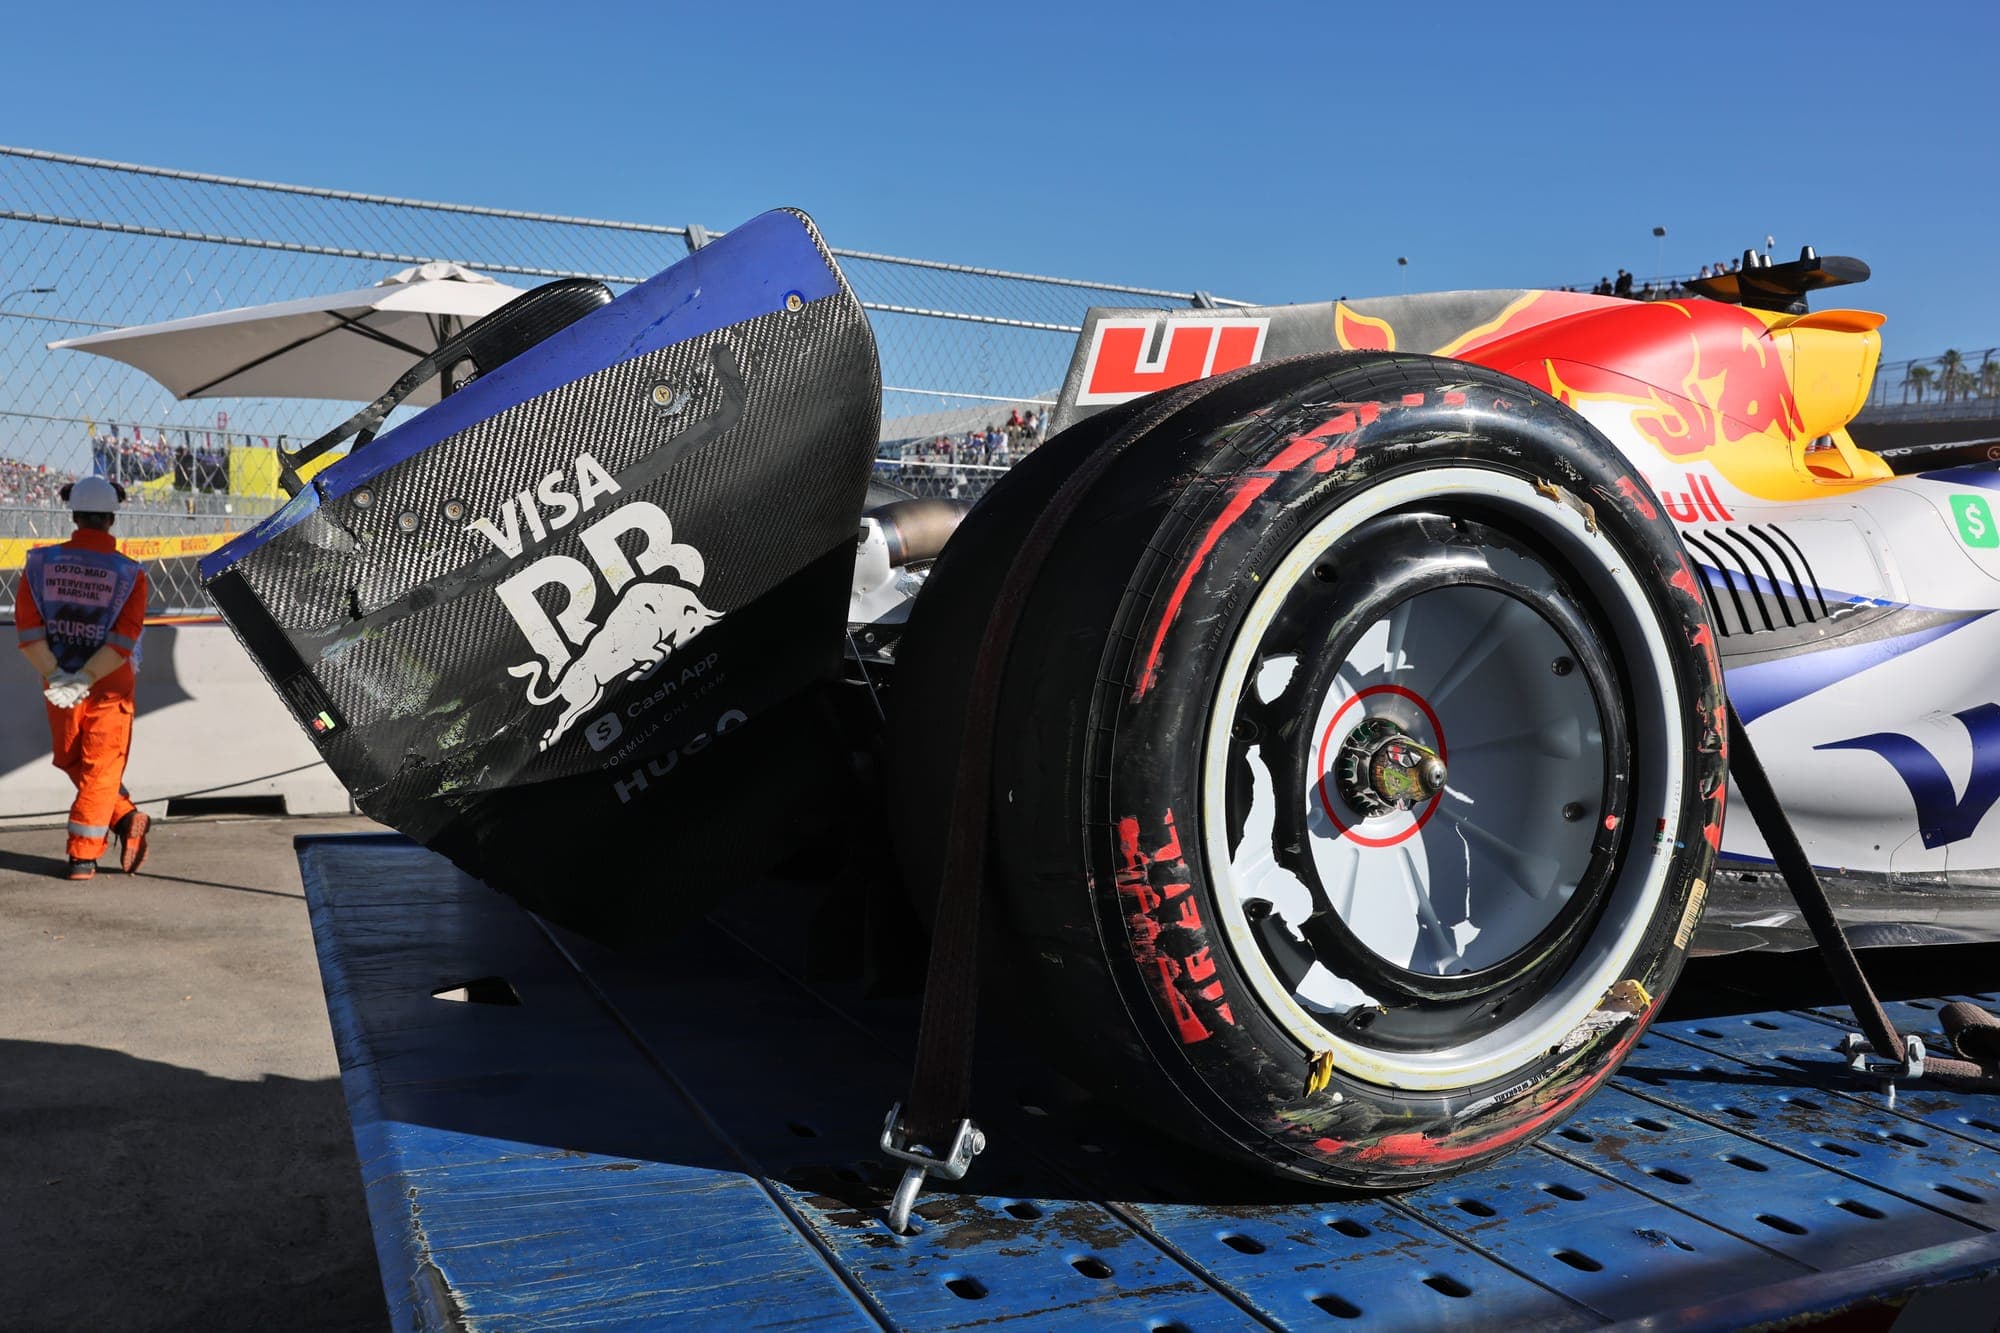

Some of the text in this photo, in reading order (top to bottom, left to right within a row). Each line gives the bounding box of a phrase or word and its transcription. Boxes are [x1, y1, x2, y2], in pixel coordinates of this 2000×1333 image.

[463, 452, 622, 559] VISA
[1641, 471, 1735, 523] ull
[46, 579, 112, 593] INTERVENTION
[57, 588, 100, 600] MARSHAL
[47, 620, 105, 640] COURSE
[626, 681, 677, 718] Cash
[680, 652, 718, 684] App
